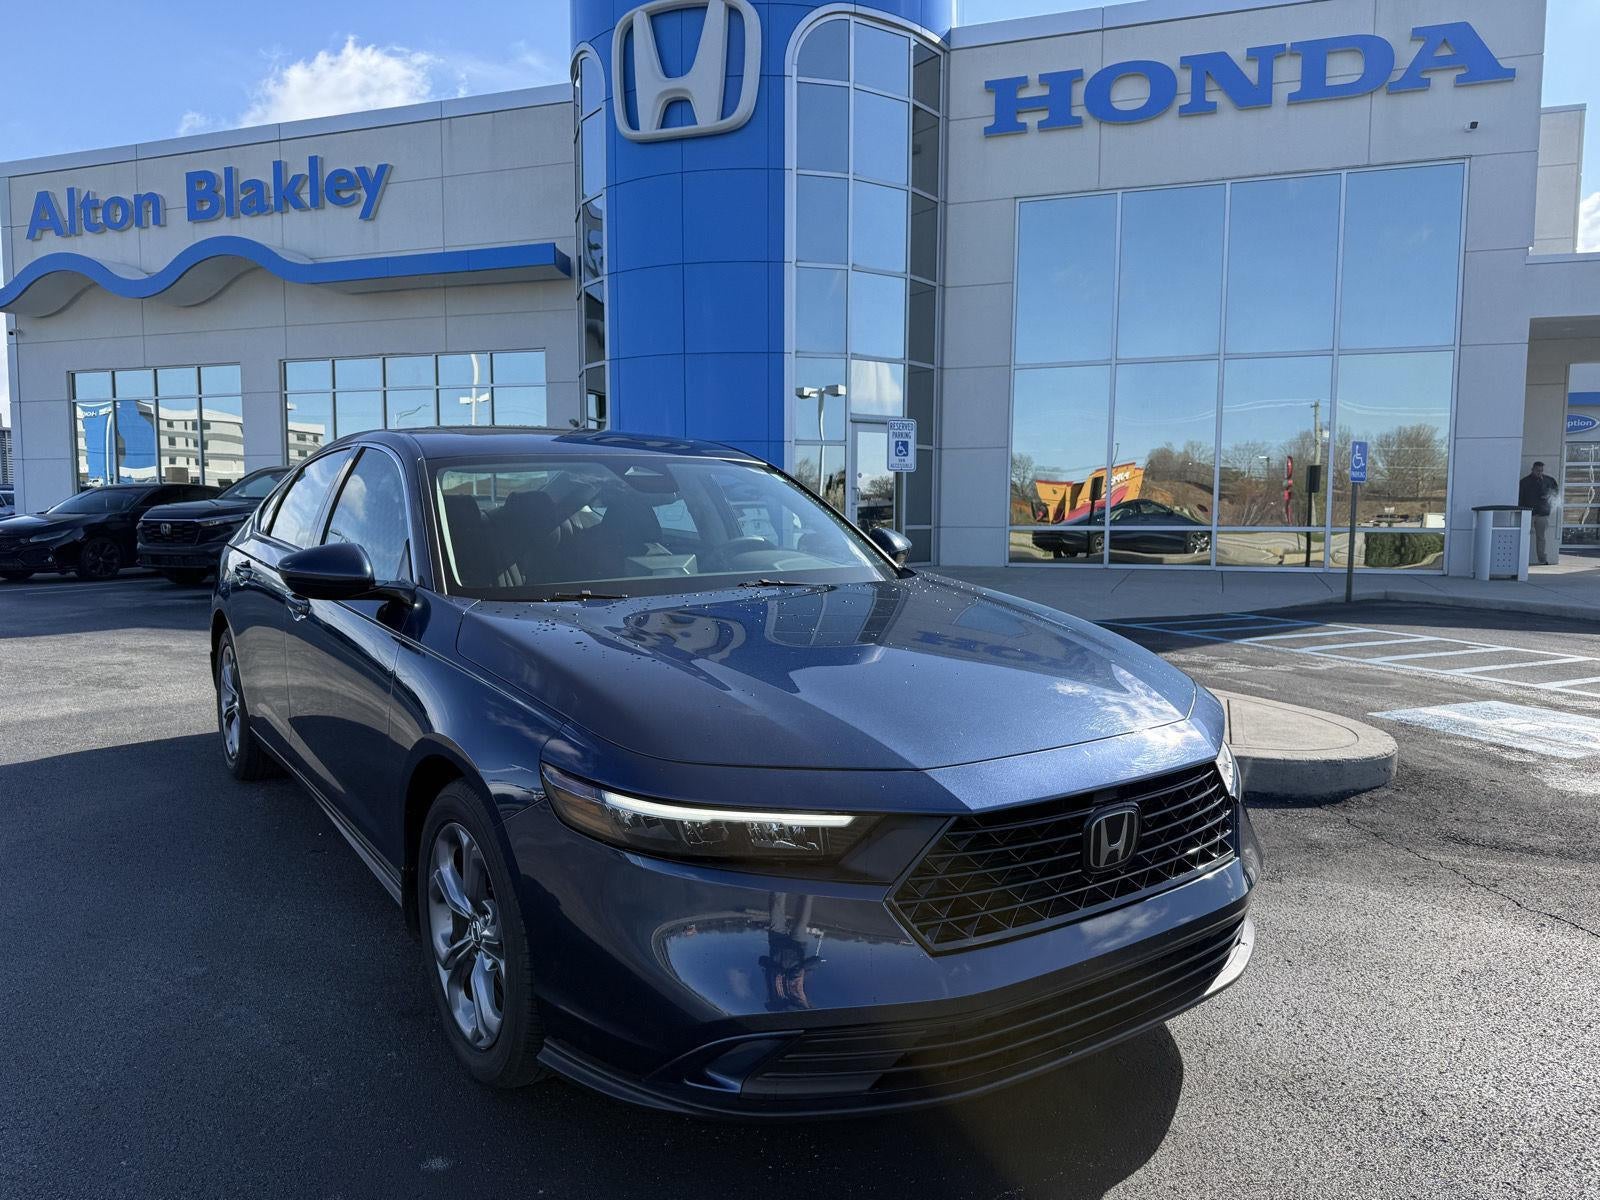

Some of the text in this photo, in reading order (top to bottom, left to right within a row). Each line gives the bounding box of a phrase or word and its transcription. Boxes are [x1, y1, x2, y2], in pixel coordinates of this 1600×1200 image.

[983, 21, 1517, 137] HONDA
[26, 155, 393, 241] Alton Blakley
[890, 422, 914, 430] RESERVED
